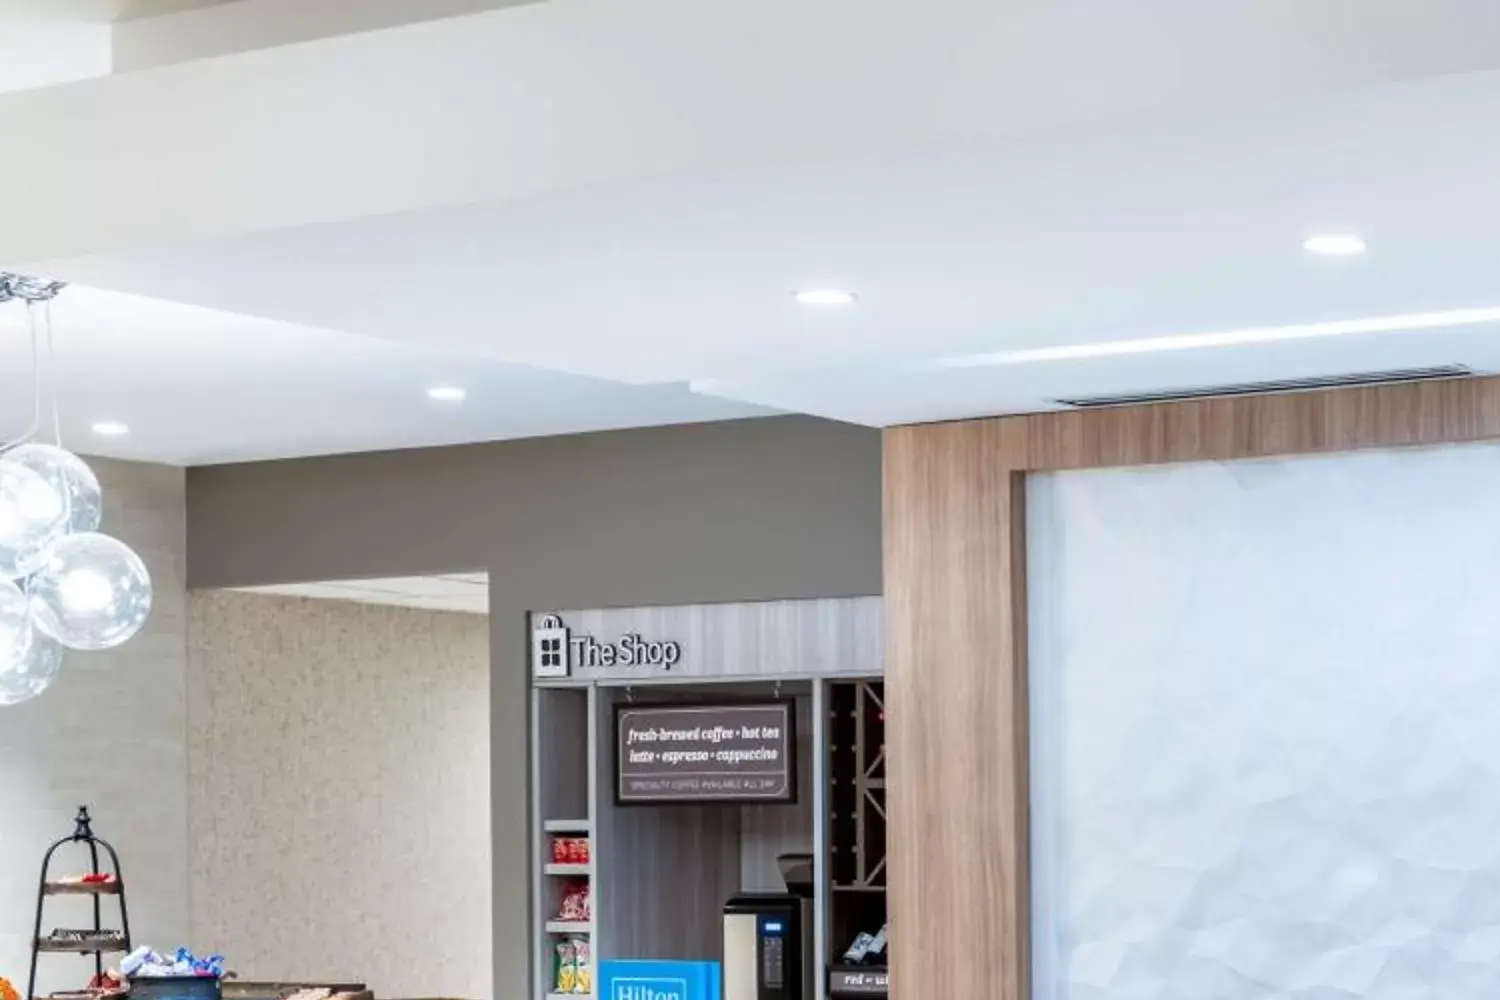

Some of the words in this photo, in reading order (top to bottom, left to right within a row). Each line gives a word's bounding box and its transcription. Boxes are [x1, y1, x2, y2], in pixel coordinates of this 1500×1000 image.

[570, 635, 617, 667] The
[619, 633, 681, 670] Shop
[701, 725, 734, 743] coffee
[741, 725, 759, 739] hot
[761, 727, 780, 739] tea
[629, 749, 654, 763] latte
[661, 750, 709, 765] espresso
[716, 746, 778, 763] cappuccino
